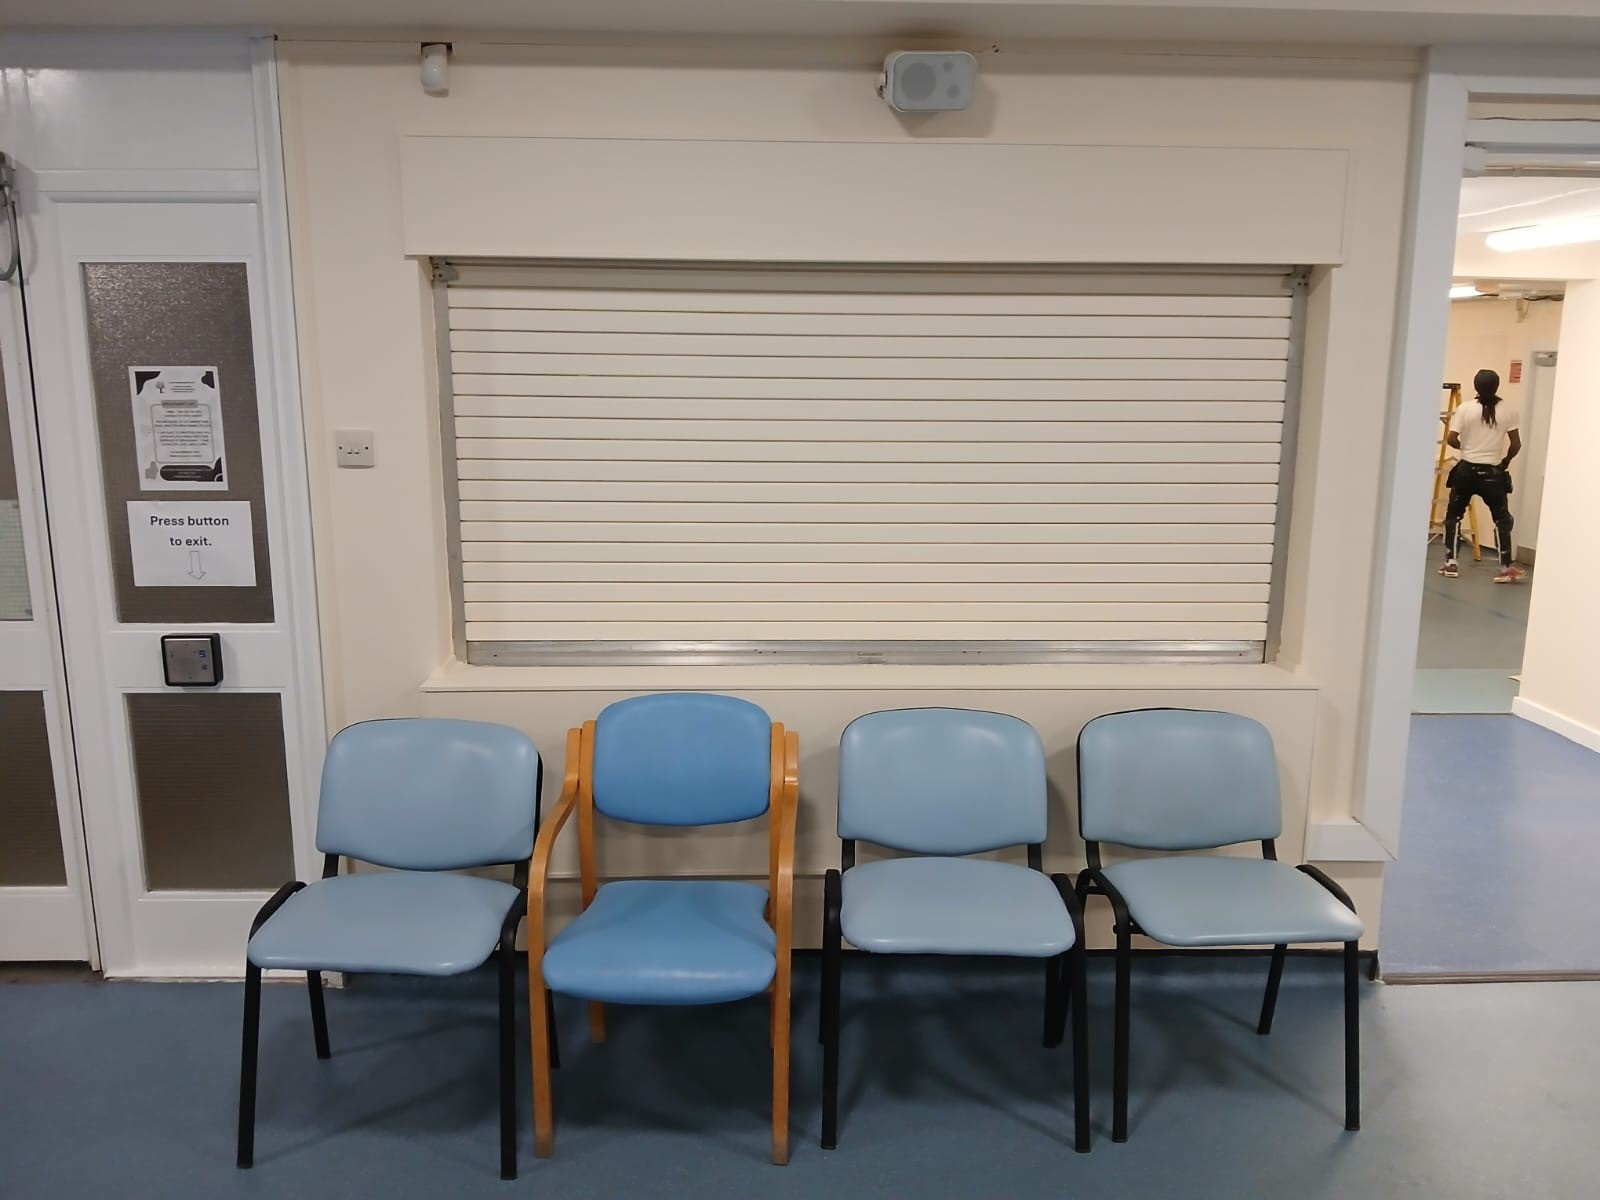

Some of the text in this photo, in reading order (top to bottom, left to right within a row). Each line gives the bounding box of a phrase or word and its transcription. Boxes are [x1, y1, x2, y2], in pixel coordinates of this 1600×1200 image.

[150, 515, 229, 526] Press button
[169, 536, 212, 546] to exit.
